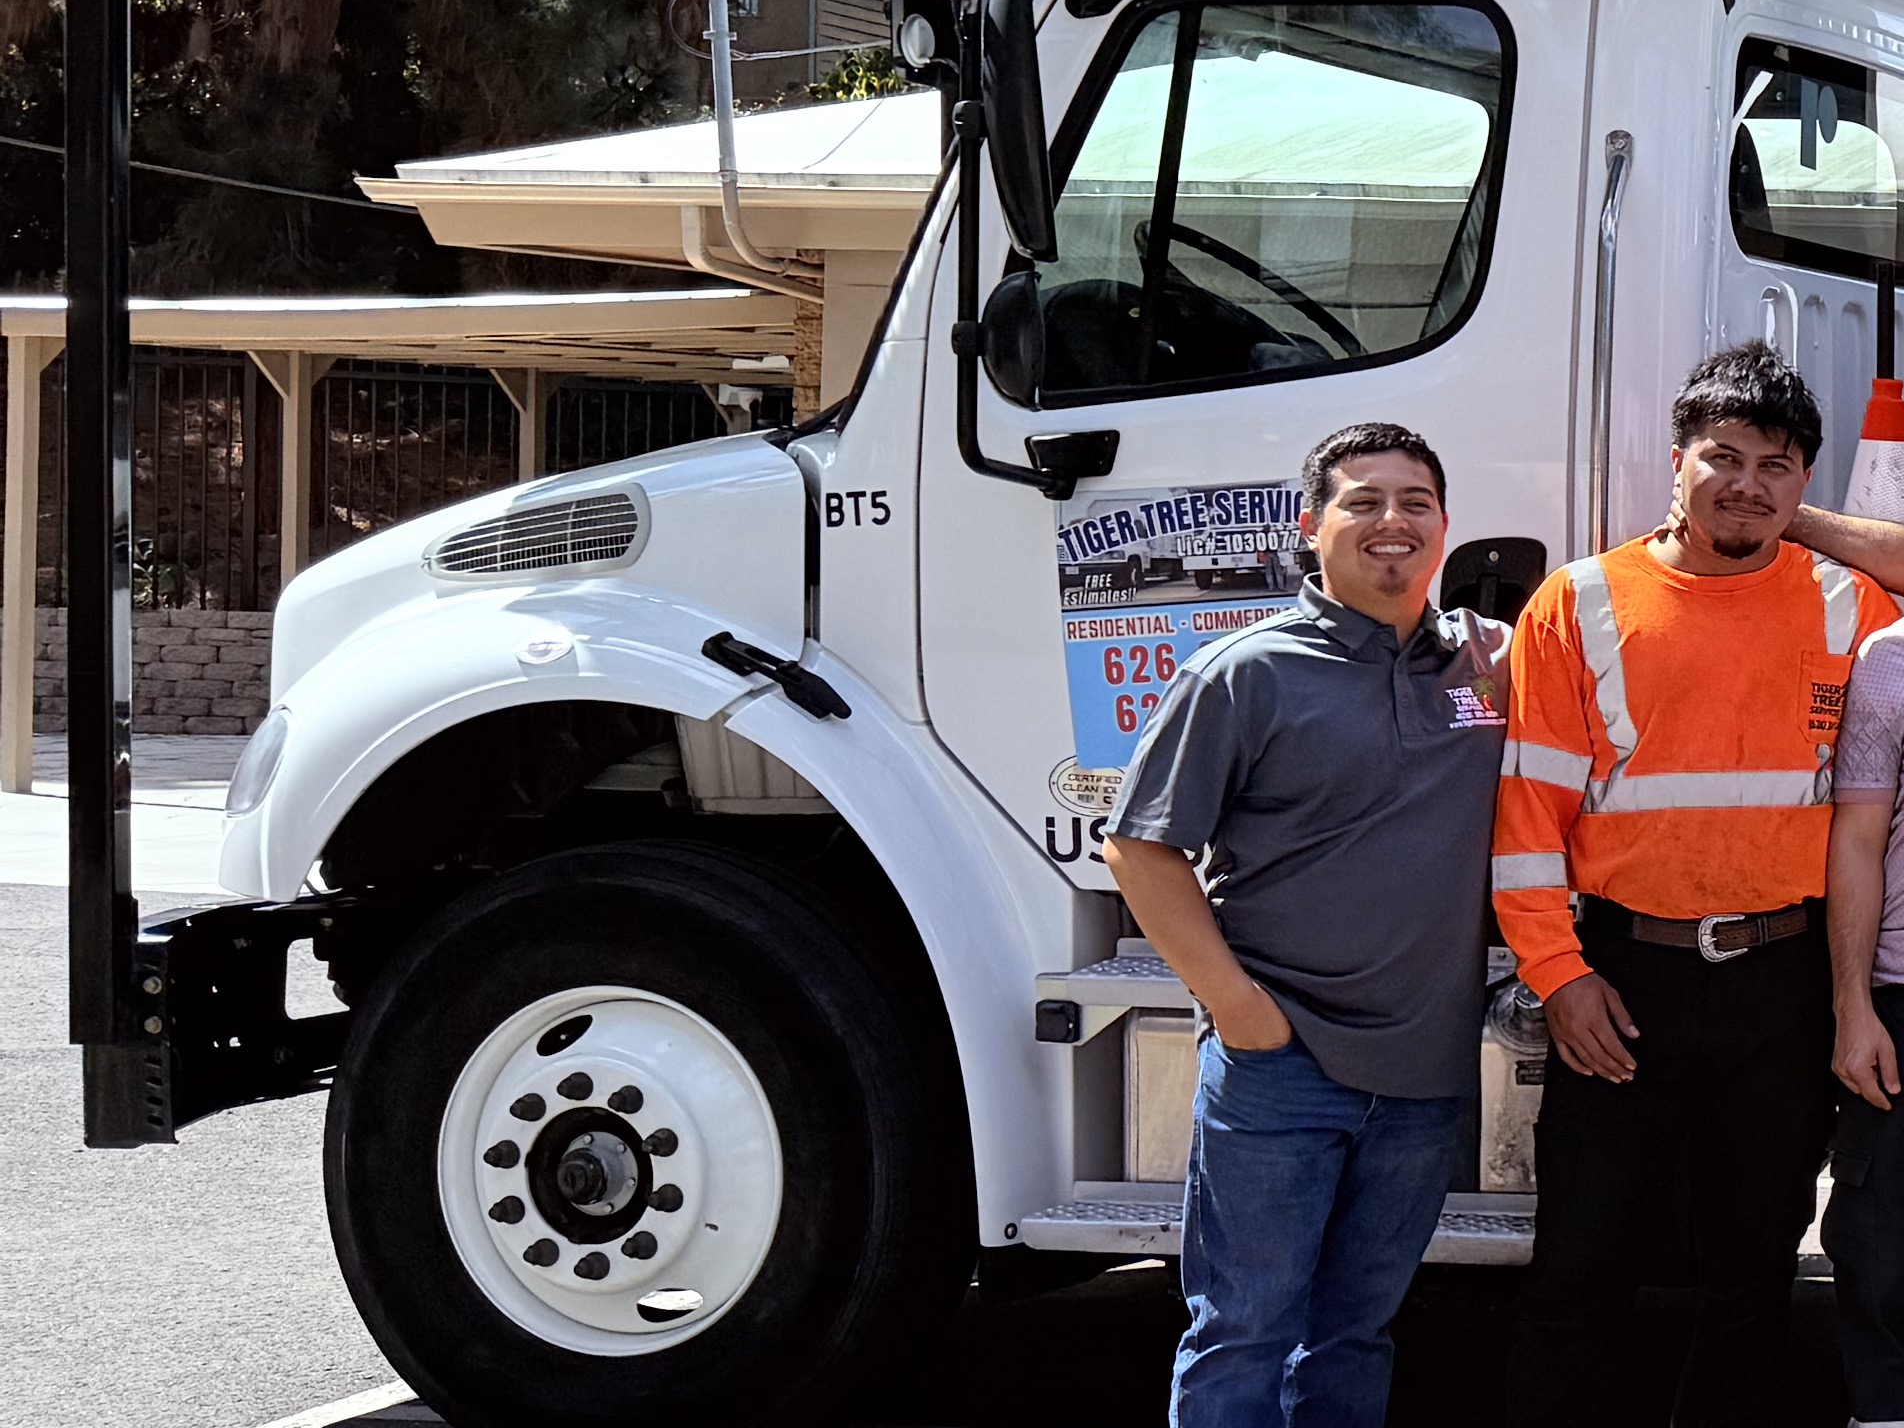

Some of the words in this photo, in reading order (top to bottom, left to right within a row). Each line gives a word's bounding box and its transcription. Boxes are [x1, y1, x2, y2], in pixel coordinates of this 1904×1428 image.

[826, 490, 891, 527] BT5
[1057, 510, 1137, 563] TIGER
[1140, 494, 1207, 539] TREE
[1213, 489, 1304, 526] SERVIC
[1176, 533, 1216, 557] Lic#
[1223, 528, 1301, 555] 1030077
[1085, 573, 1113, 589] FREE
[1067, 614, 1175, 641] RESIDENTIAL
[1193, 607, 1290, 631] COMMER
[1103, 643, 1176, 686] 626
[1062, 783, 1099, 793] CLEAN
